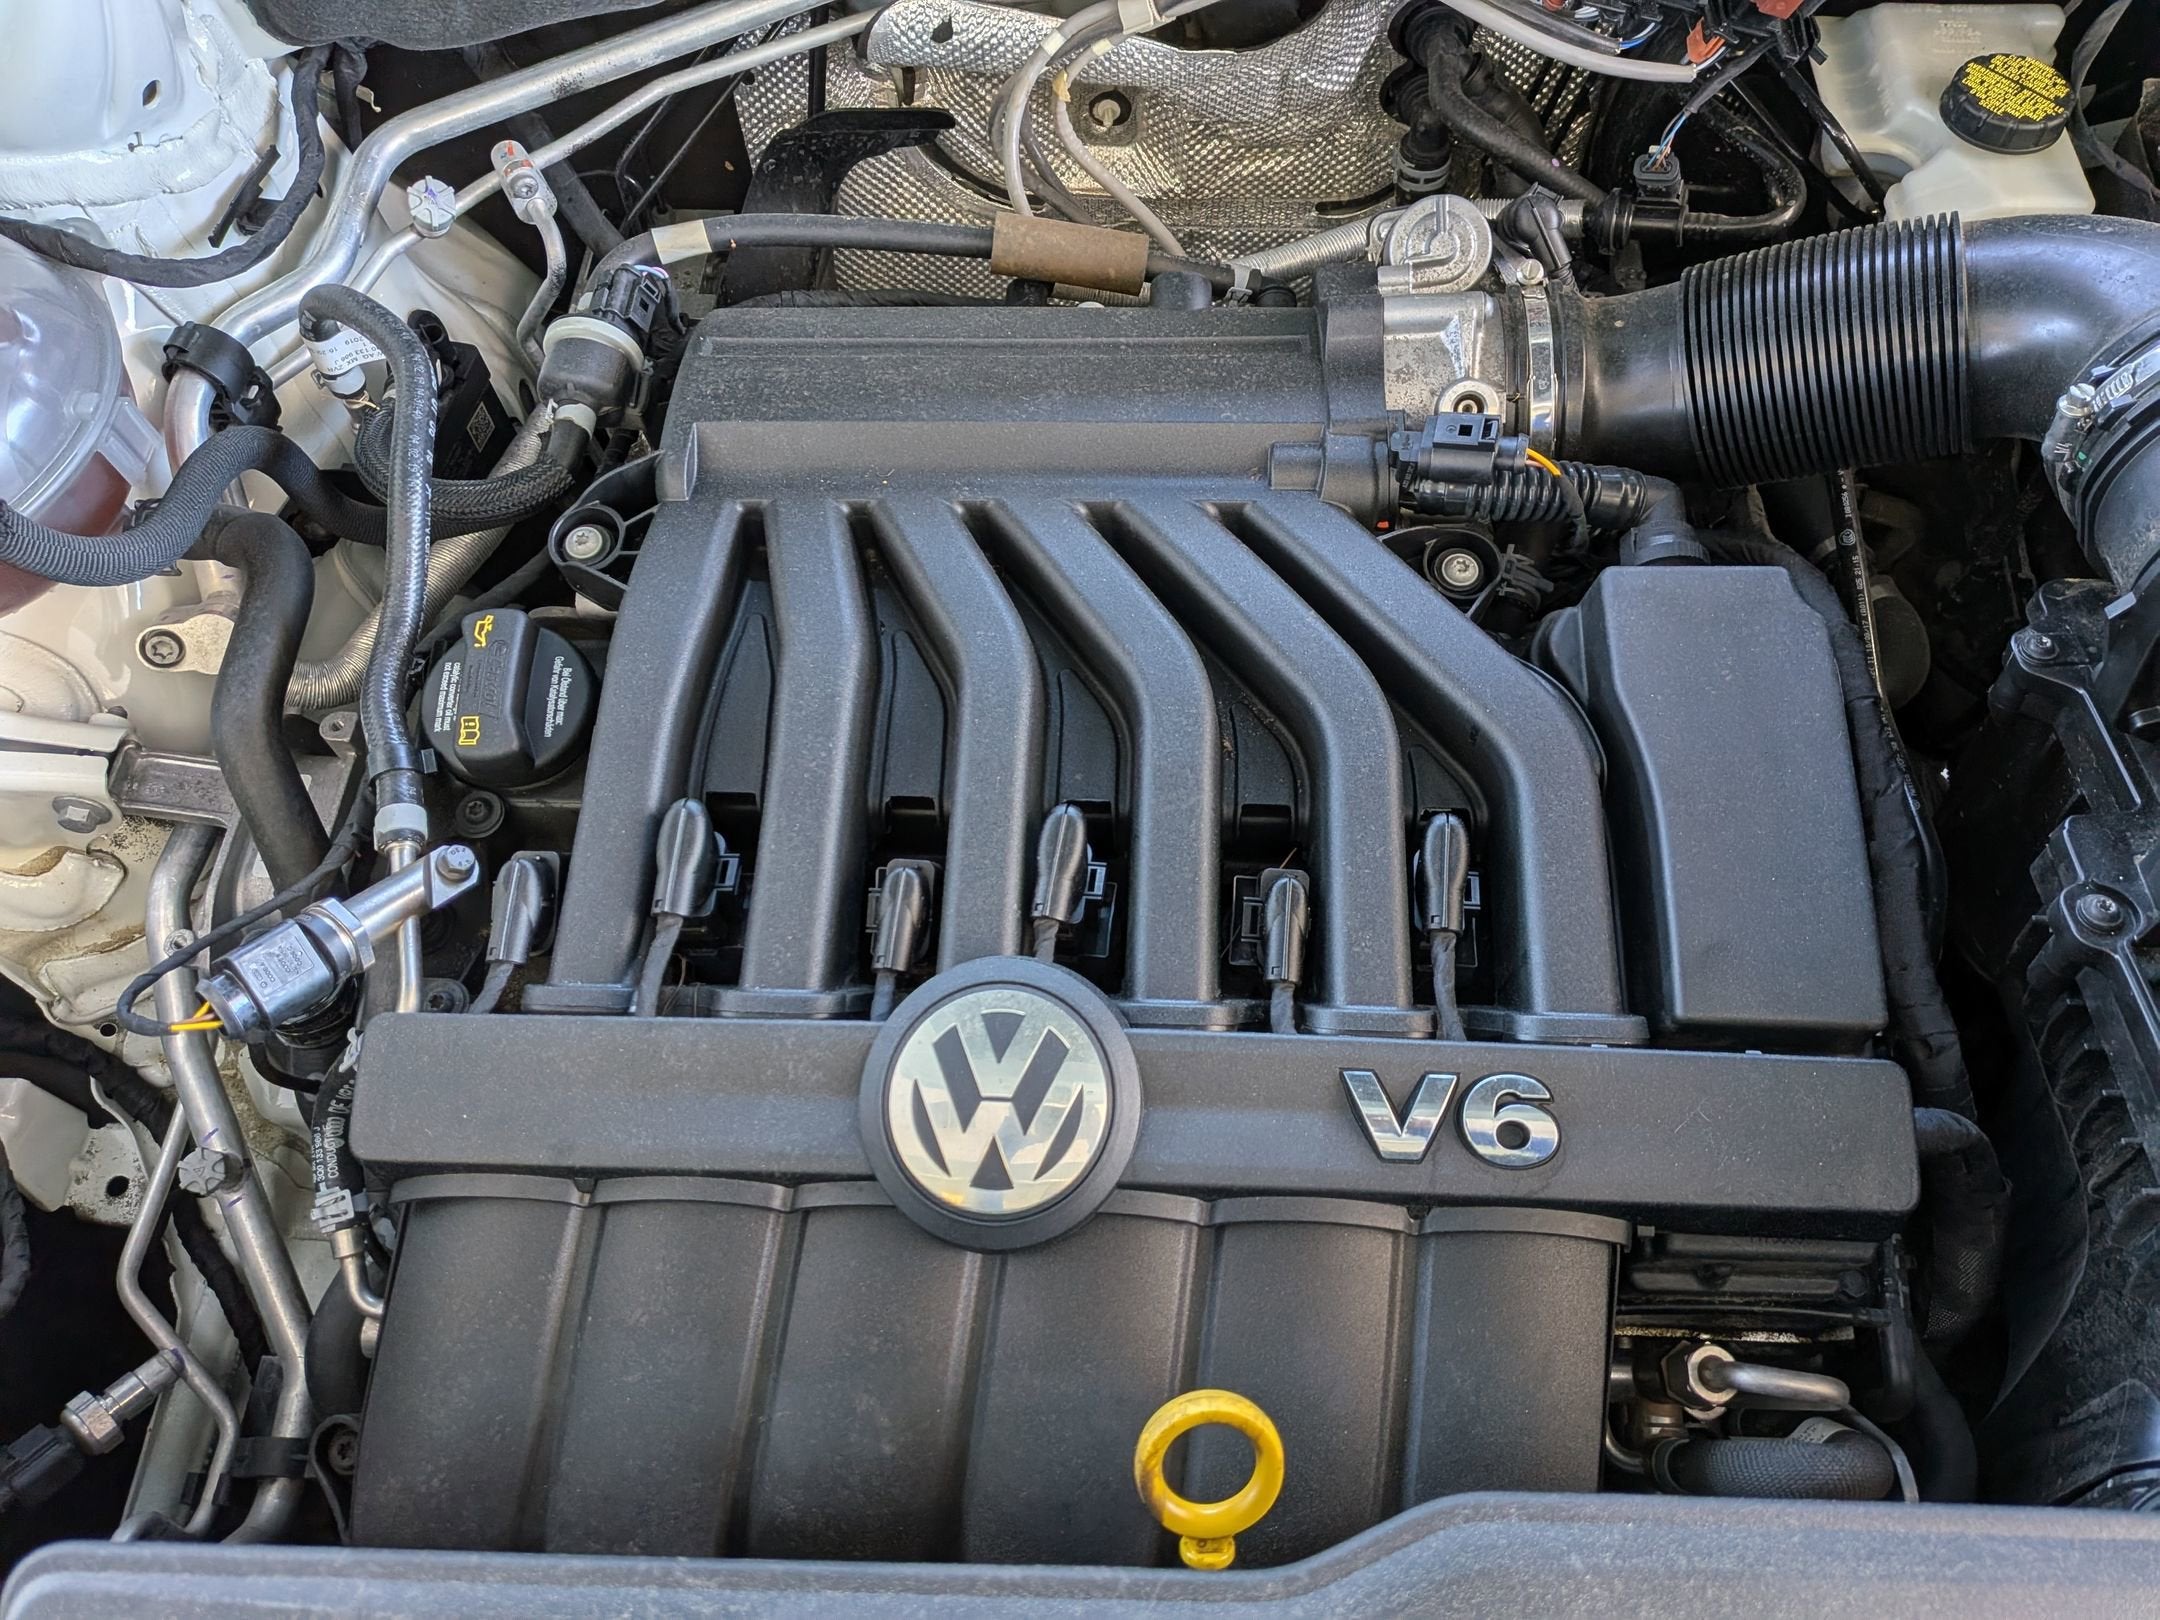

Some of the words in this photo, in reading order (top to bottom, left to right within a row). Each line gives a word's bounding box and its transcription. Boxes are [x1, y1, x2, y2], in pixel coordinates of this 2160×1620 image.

[444, 662, 452, 672] not
[553, 656, 564, 674] Gefahr
[440, 671, 450, 690] exceed
[436, 691, 446, 718] maximum
[434, 717, 442, 732] mark
[443, 716, 451, 731] must
[1339, 1067, 1561, 1169] V6
